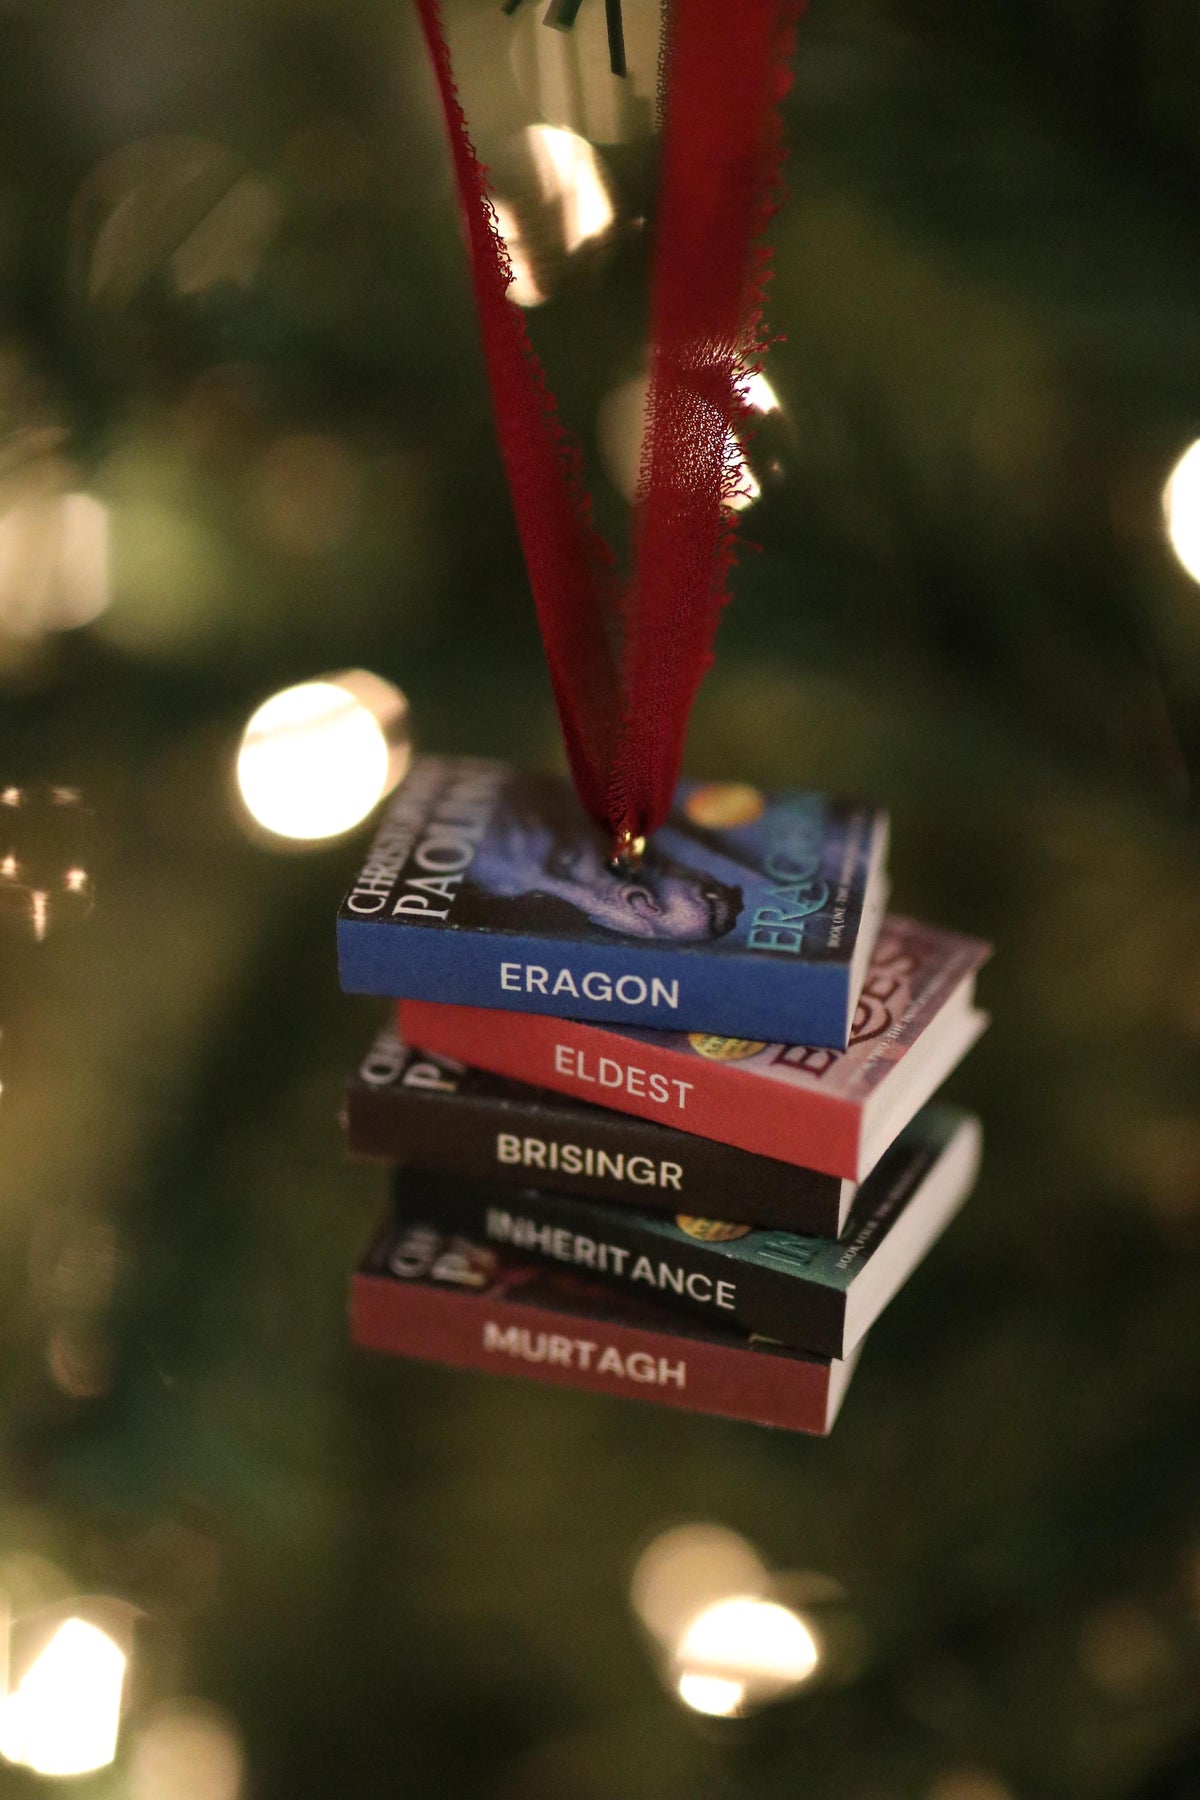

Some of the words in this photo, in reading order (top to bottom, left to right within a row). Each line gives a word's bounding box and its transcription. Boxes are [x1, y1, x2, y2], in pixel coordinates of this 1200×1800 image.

[500, 962, 679, 1009] ERAGON
[555, 1044, 694, 1110] ELDEST
[497, 1133, 684, 1190] BRISINGR
[486, 1208, 737, 1310] INHERITANCE
[482, 1321, 686, 1390] MURTAGH
